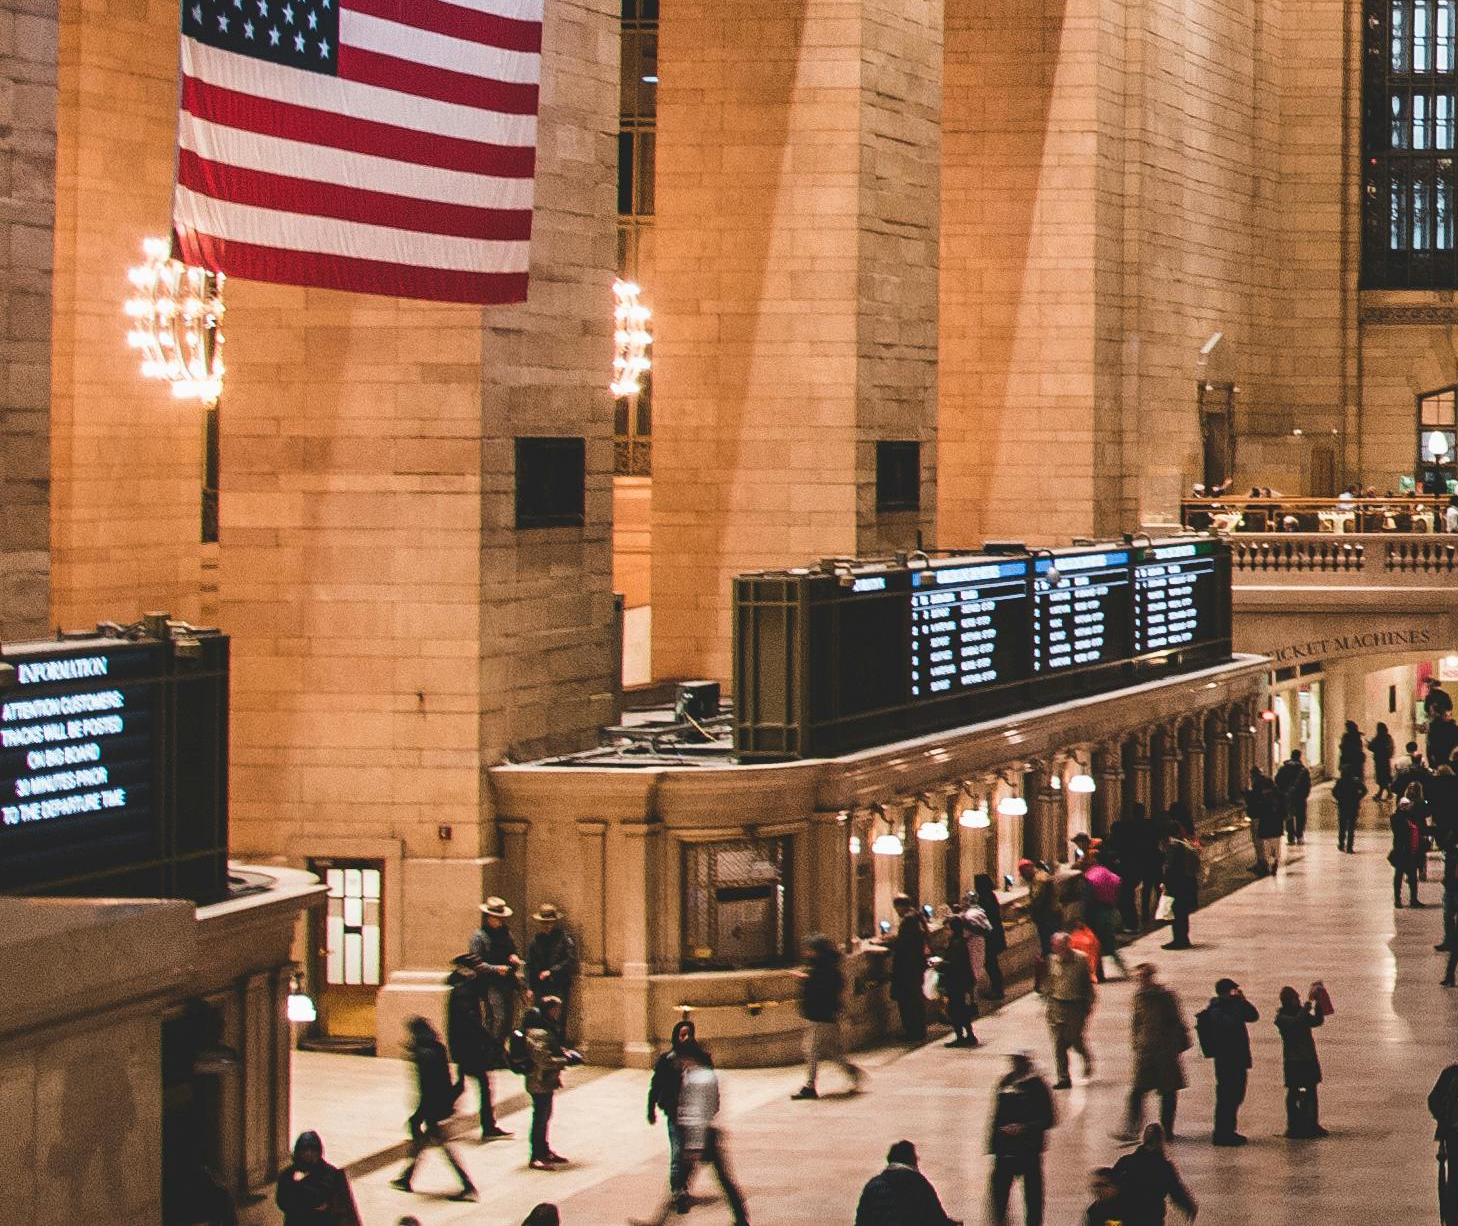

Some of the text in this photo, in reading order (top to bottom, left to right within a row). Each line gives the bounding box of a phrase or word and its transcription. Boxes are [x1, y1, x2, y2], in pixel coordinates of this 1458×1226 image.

[1334, 628, 1430, 649] MACHINES
[17, 656, 108, 684] INFORMATION
[2, 697, 61, 722] ATTENTION
[0, 714, 124, 748] TRACKS WILL BE POSTED
[27, 742, 100, 770] ON BIG BOARD
[30, 771, 77, 795] MINUTES
[75, 766, 108, 788] PRIOR
[1, 788, 126, 825] TO THE DEPARTURE TIME
